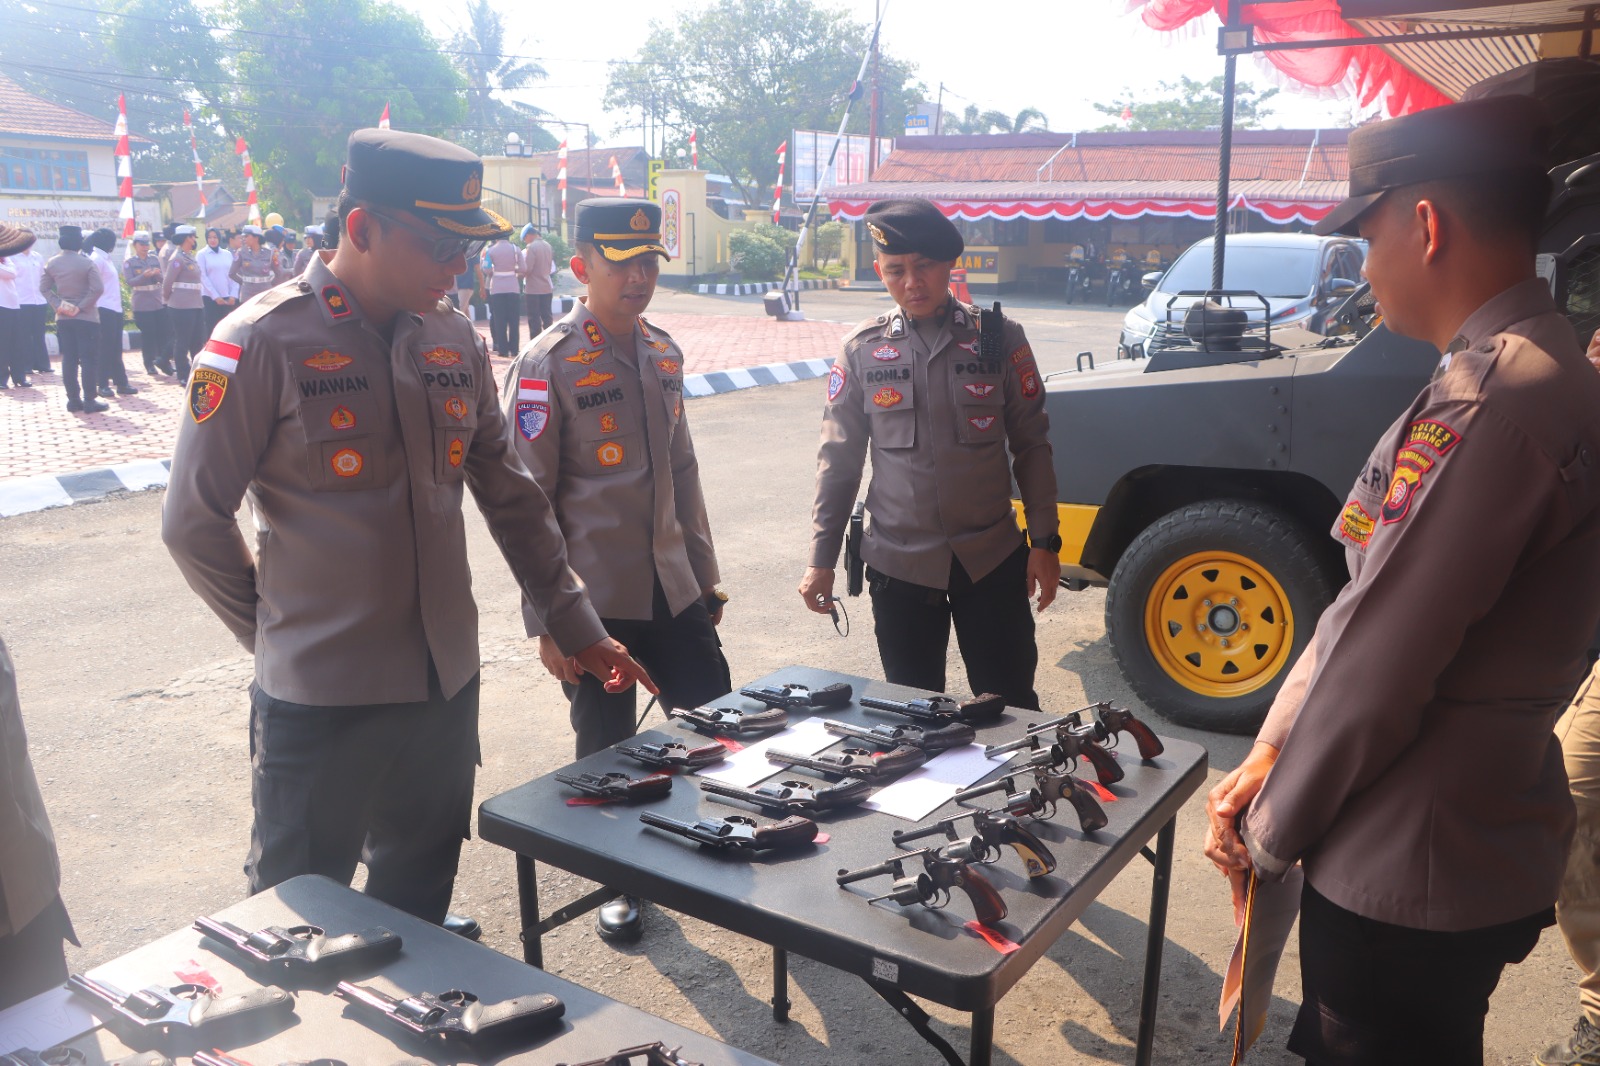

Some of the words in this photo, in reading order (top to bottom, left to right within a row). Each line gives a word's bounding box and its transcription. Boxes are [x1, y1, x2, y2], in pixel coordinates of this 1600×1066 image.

[907, 118, 926, 127] atm
[867, 368, 910, 384] RONI.S
[955, 361, 1002, 375] POLRI
[196, 371, 225, 386] RESERSE
[300, 375, 369, 398] WAWAN
[424, 372, 474, 389] POLRI
[577, 391, 607, 410] BUDI
[608, 388, 624, 402] HS
[1410, 432, 1443, 448] SINTANG
[1411, 422, 1451, 442] POLRES
